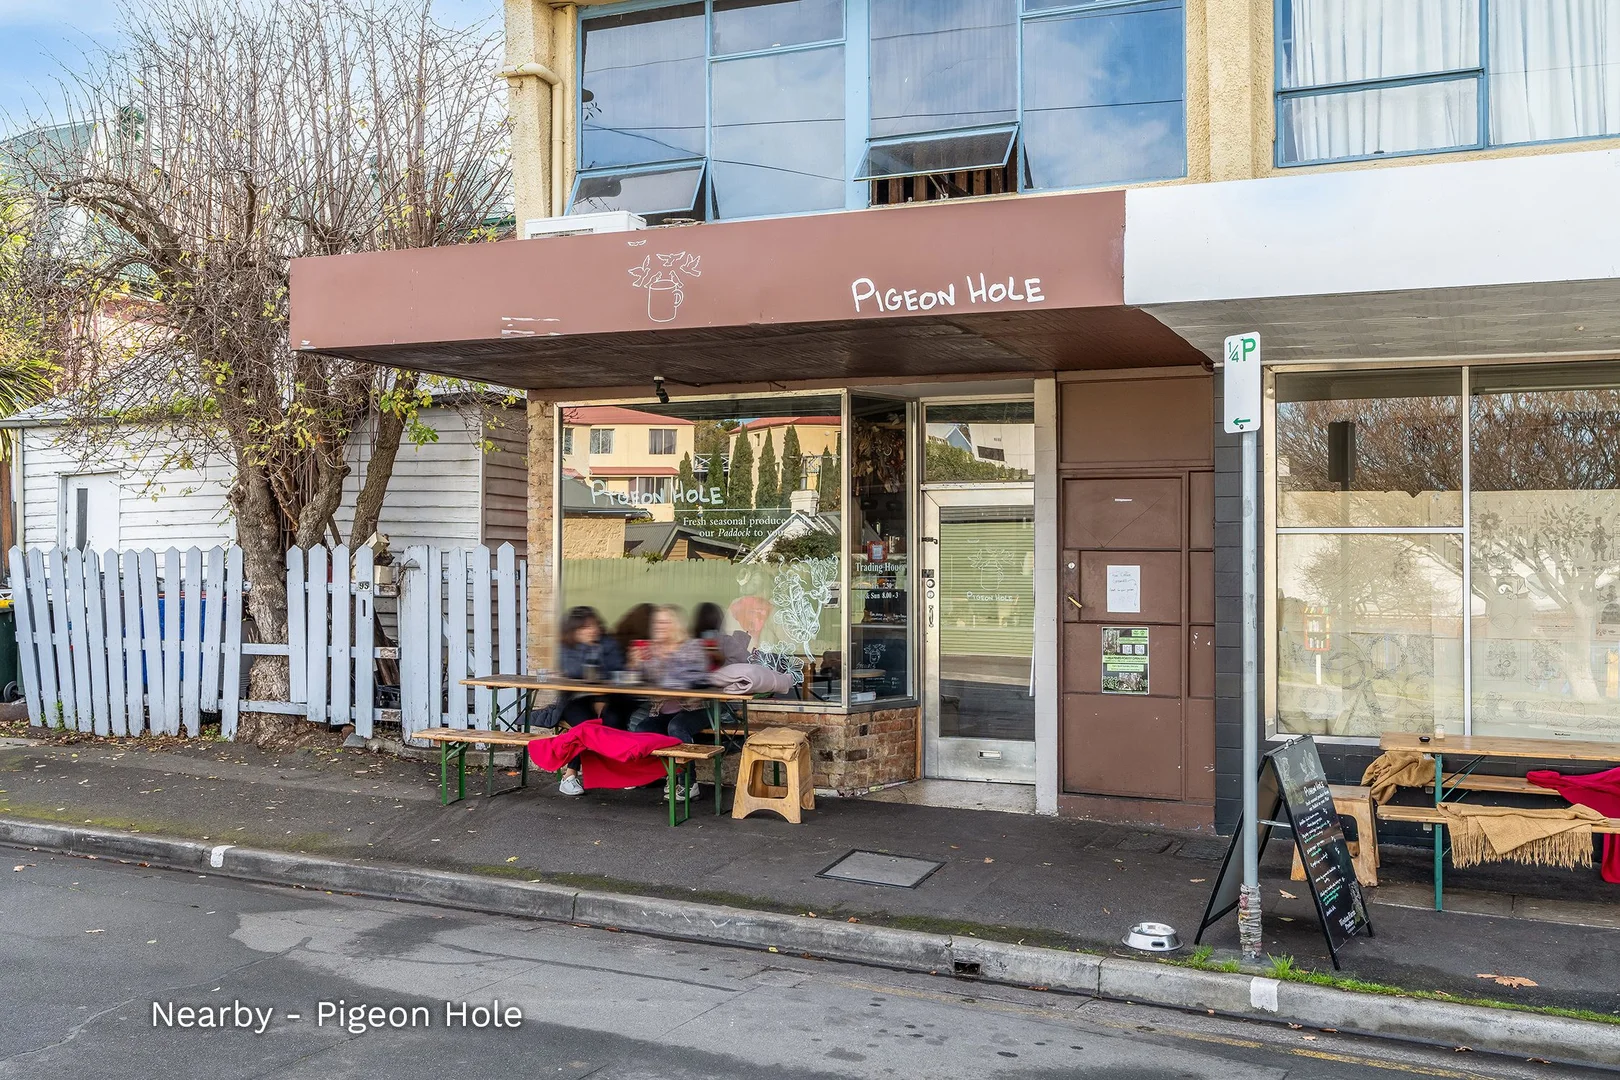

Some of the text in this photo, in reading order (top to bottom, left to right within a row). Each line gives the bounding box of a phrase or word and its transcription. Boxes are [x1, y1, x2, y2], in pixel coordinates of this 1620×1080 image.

[851, 272, 1045, 312] PIGEON HOLE
[671, 480, 724, 505] HOLE
[683, 516, 707, 526] Fresh
[709, 515, 746, 526] seasonal
[699, 530, 715, 538] our
[718, 527, 751, 537] Paddock
[753, 529, 764, 537] to
[855, 562, 884, 574] Trading
